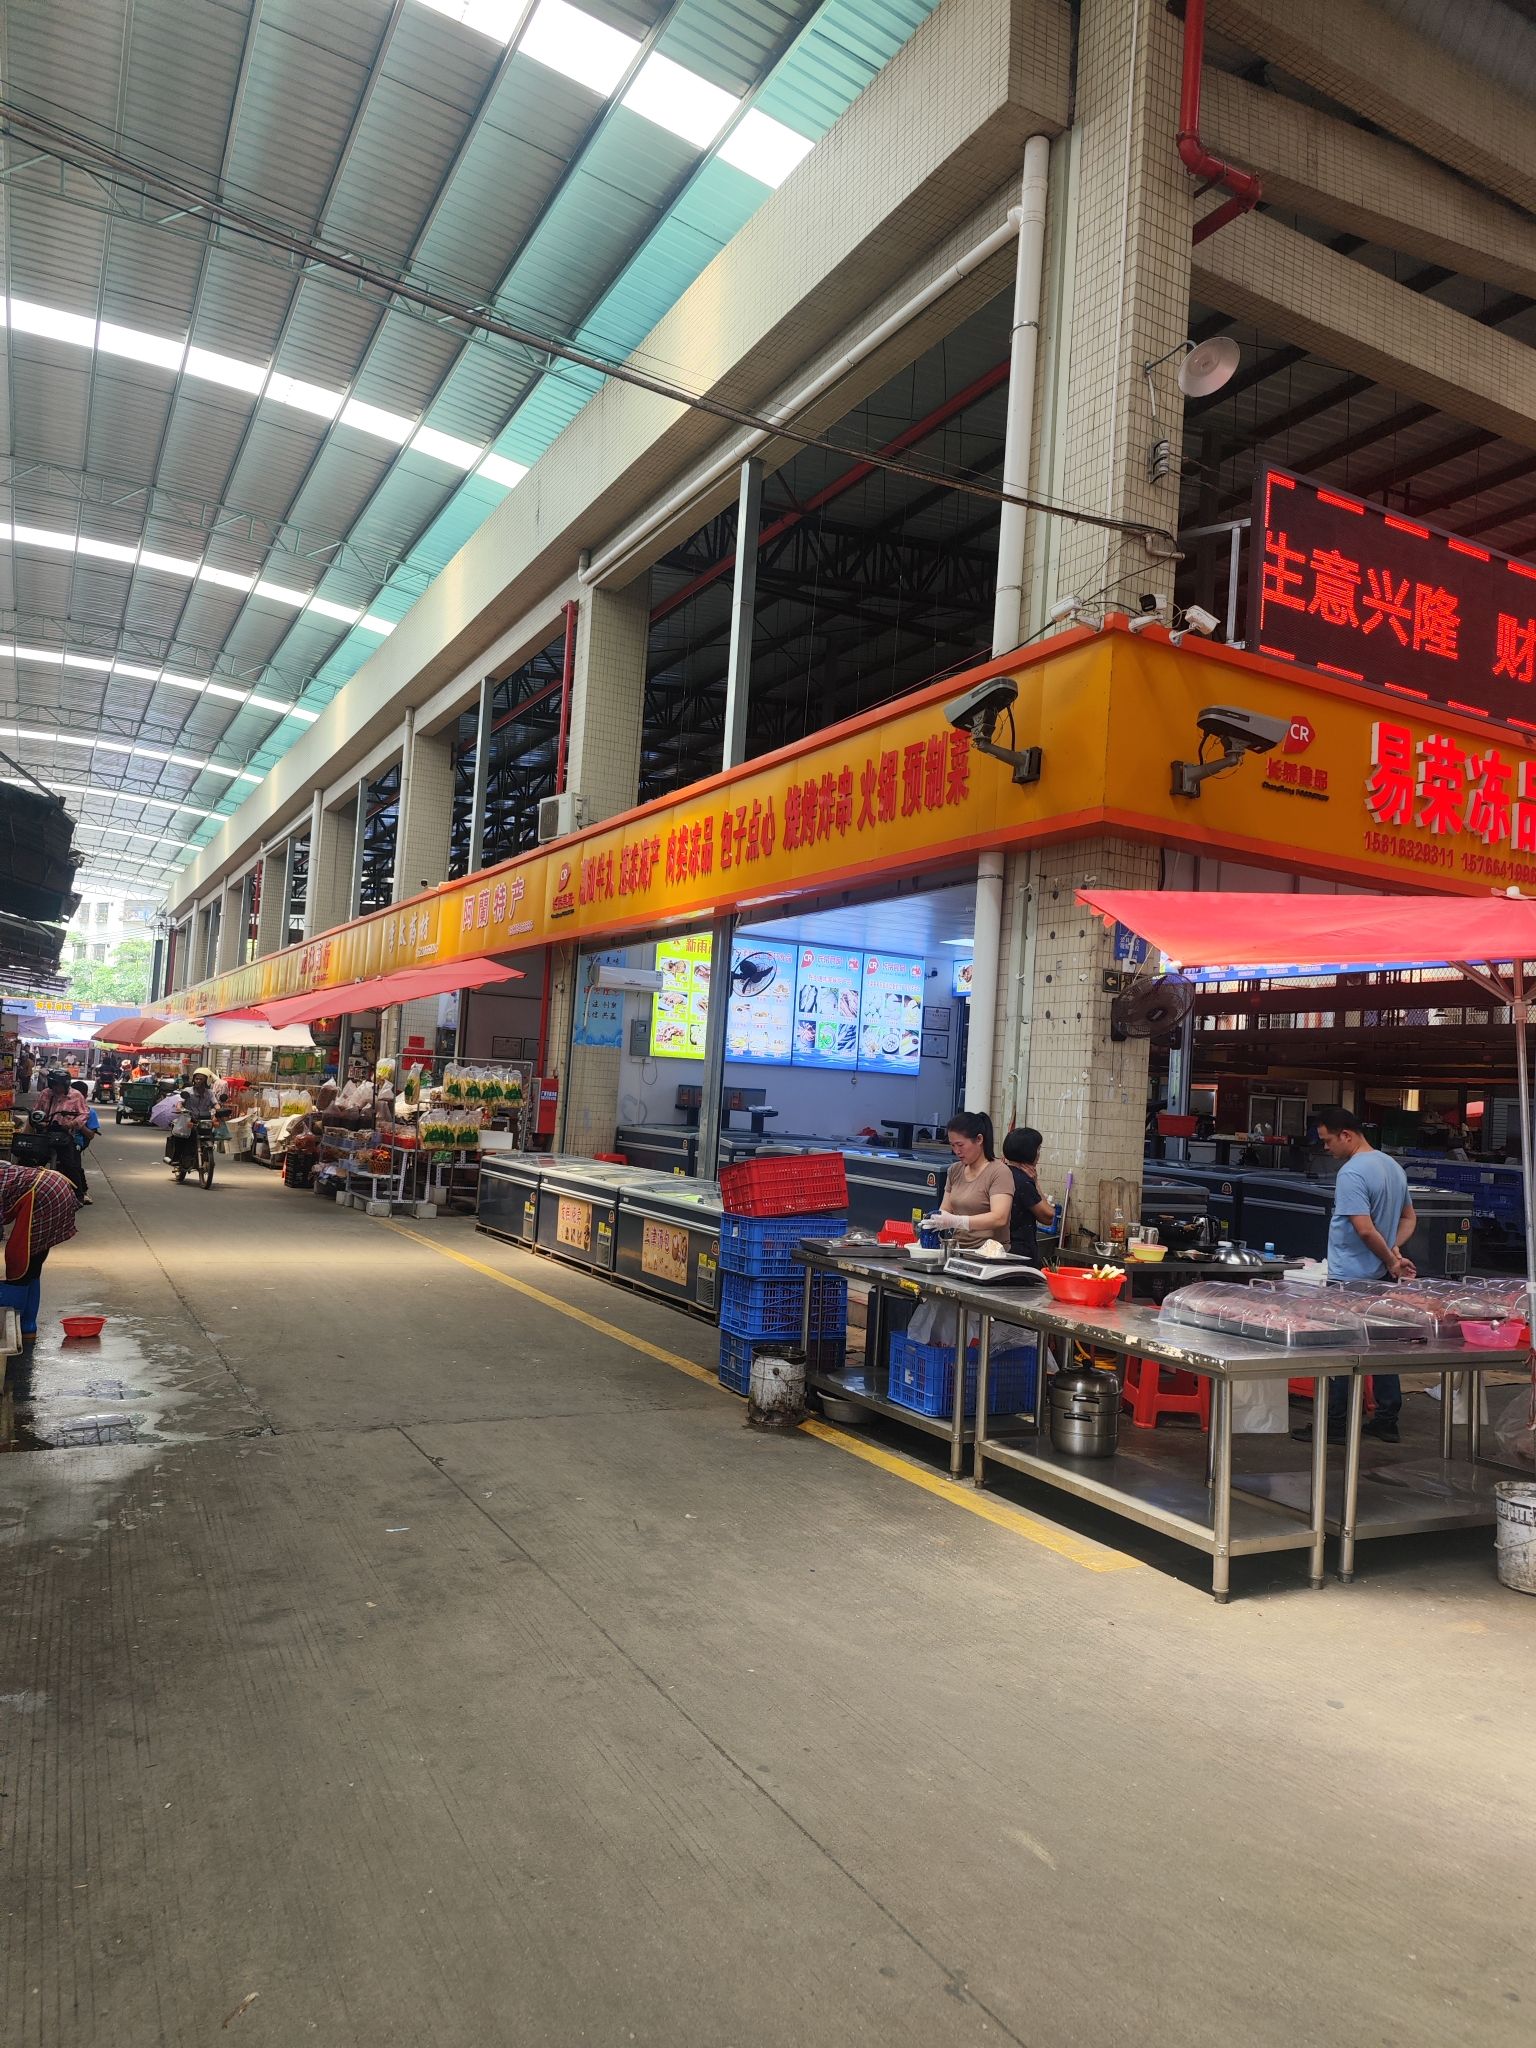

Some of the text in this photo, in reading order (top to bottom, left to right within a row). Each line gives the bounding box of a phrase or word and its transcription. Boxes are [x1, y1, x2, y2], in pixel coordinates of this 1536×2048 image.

[1262, 530, 1461, 660] 生意兴隆
[1289, 723, 1310, 742] CR
[720, 795, 776, 869] 包子点心
[782, 764, 854, 850] 烧烤炸串
[856, 749, 899, 832] 火锅
[901, 728, 972, 817] 预制菜
